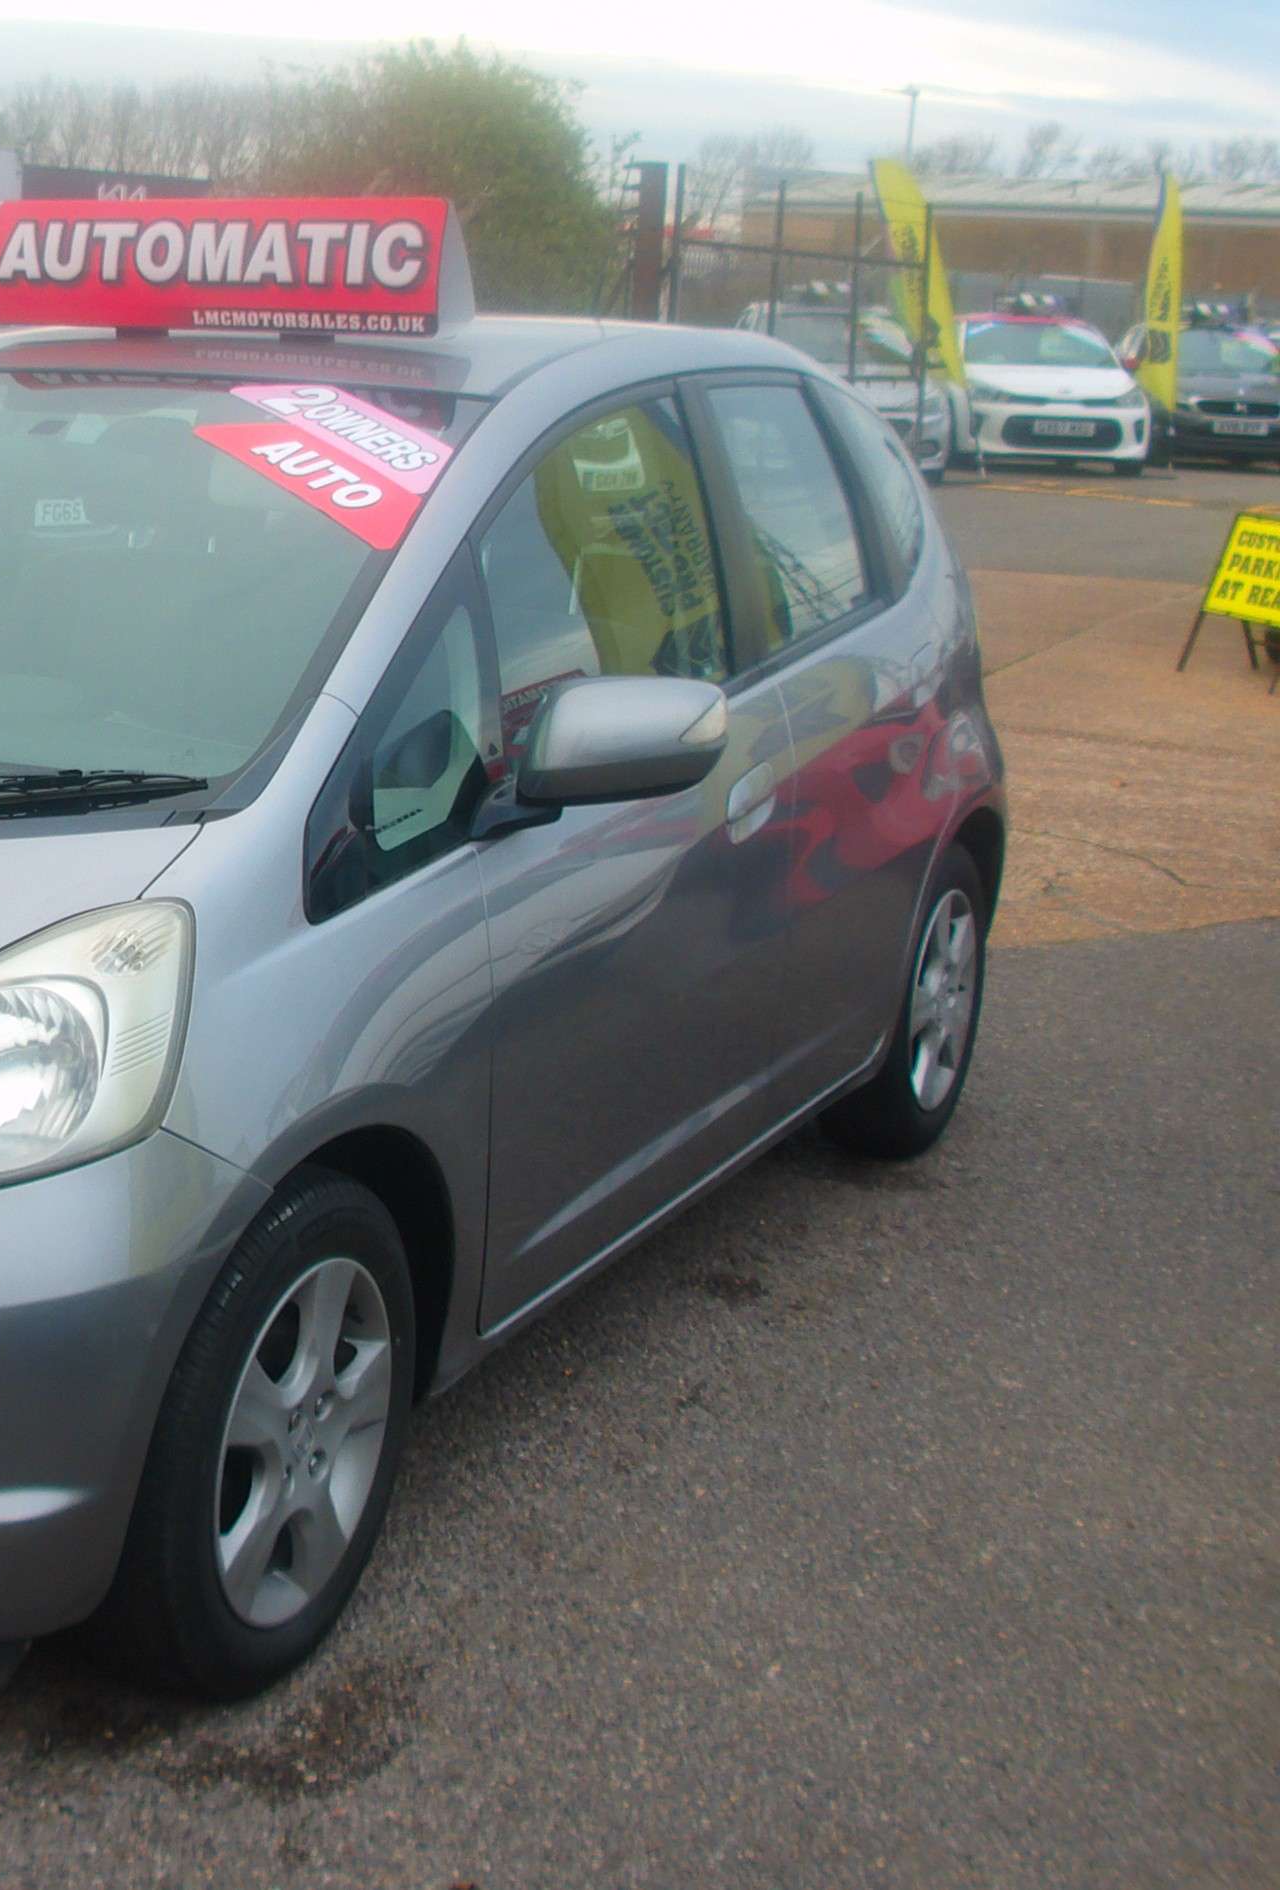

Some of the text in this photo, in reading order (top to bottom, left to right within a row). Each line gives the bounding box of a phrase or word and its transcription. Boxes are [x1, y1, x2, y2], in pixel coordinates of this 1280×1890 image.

[191, 309, 425, 333] LMCMOTORSALES.CO.UK
[259, 386, 441, 473] 2 OWNERS
[250, 440, 384, 509] AUTO
[1216, 579, 1245, 601] AT
